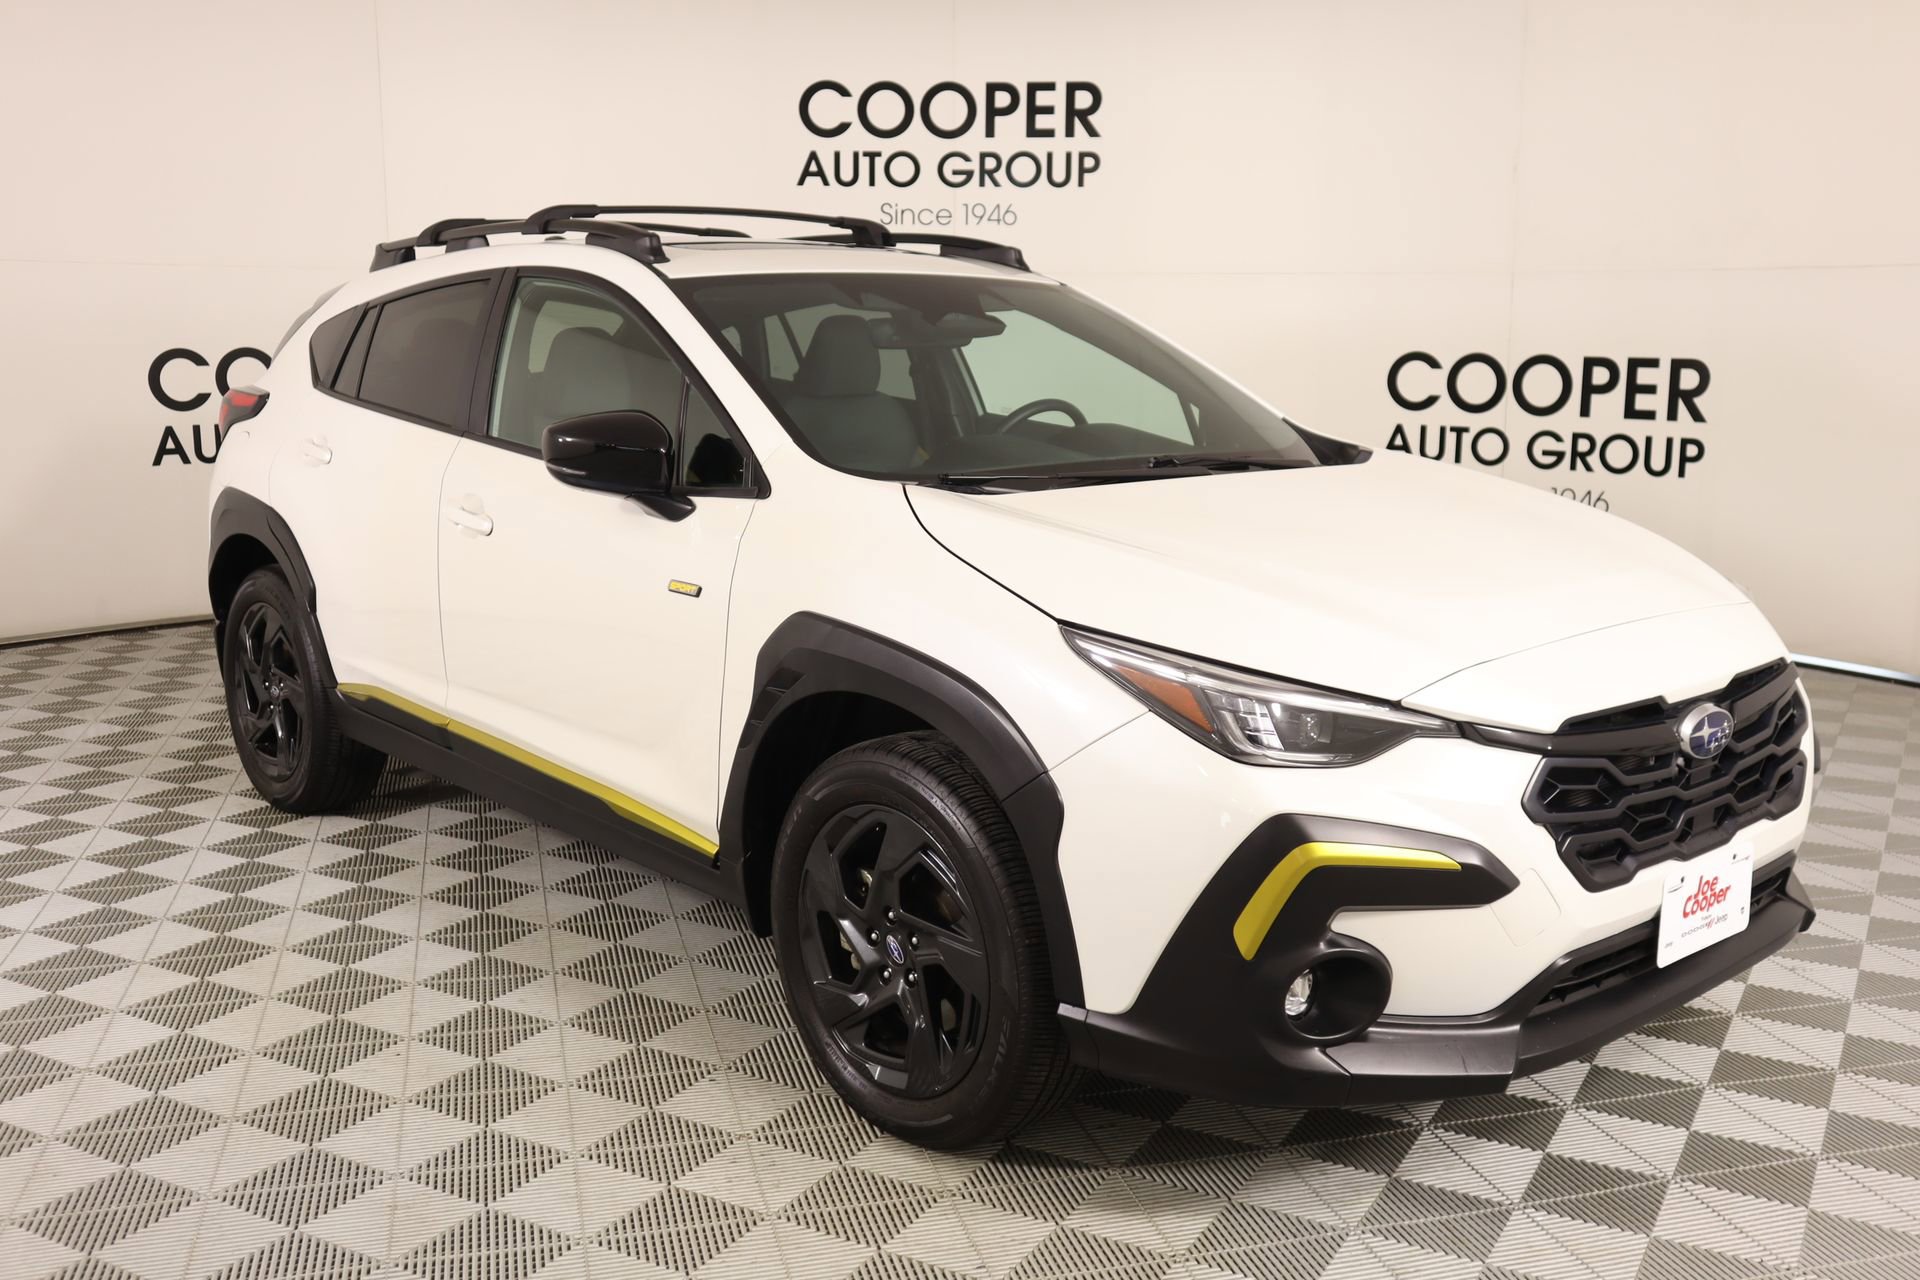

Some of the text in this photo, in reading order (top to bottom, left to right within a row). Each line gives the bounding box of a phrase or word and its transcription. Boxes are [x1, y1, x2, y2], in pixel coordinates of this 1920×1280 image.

[799, 80, 1102, 139] COOPER
[797, 150, 1101, 188] AUTO GROUP
[879, 203, 1017, 226] Since 1946
[1387, 351, 1711, 423] COOPER
[1386, 424, 1706, 478] AUTO GROUP
[1552, 487, 1609, 512] 946
[1682, 885, 1731, 918] Cooper
[1694, 875, 1718, 898] Joe
